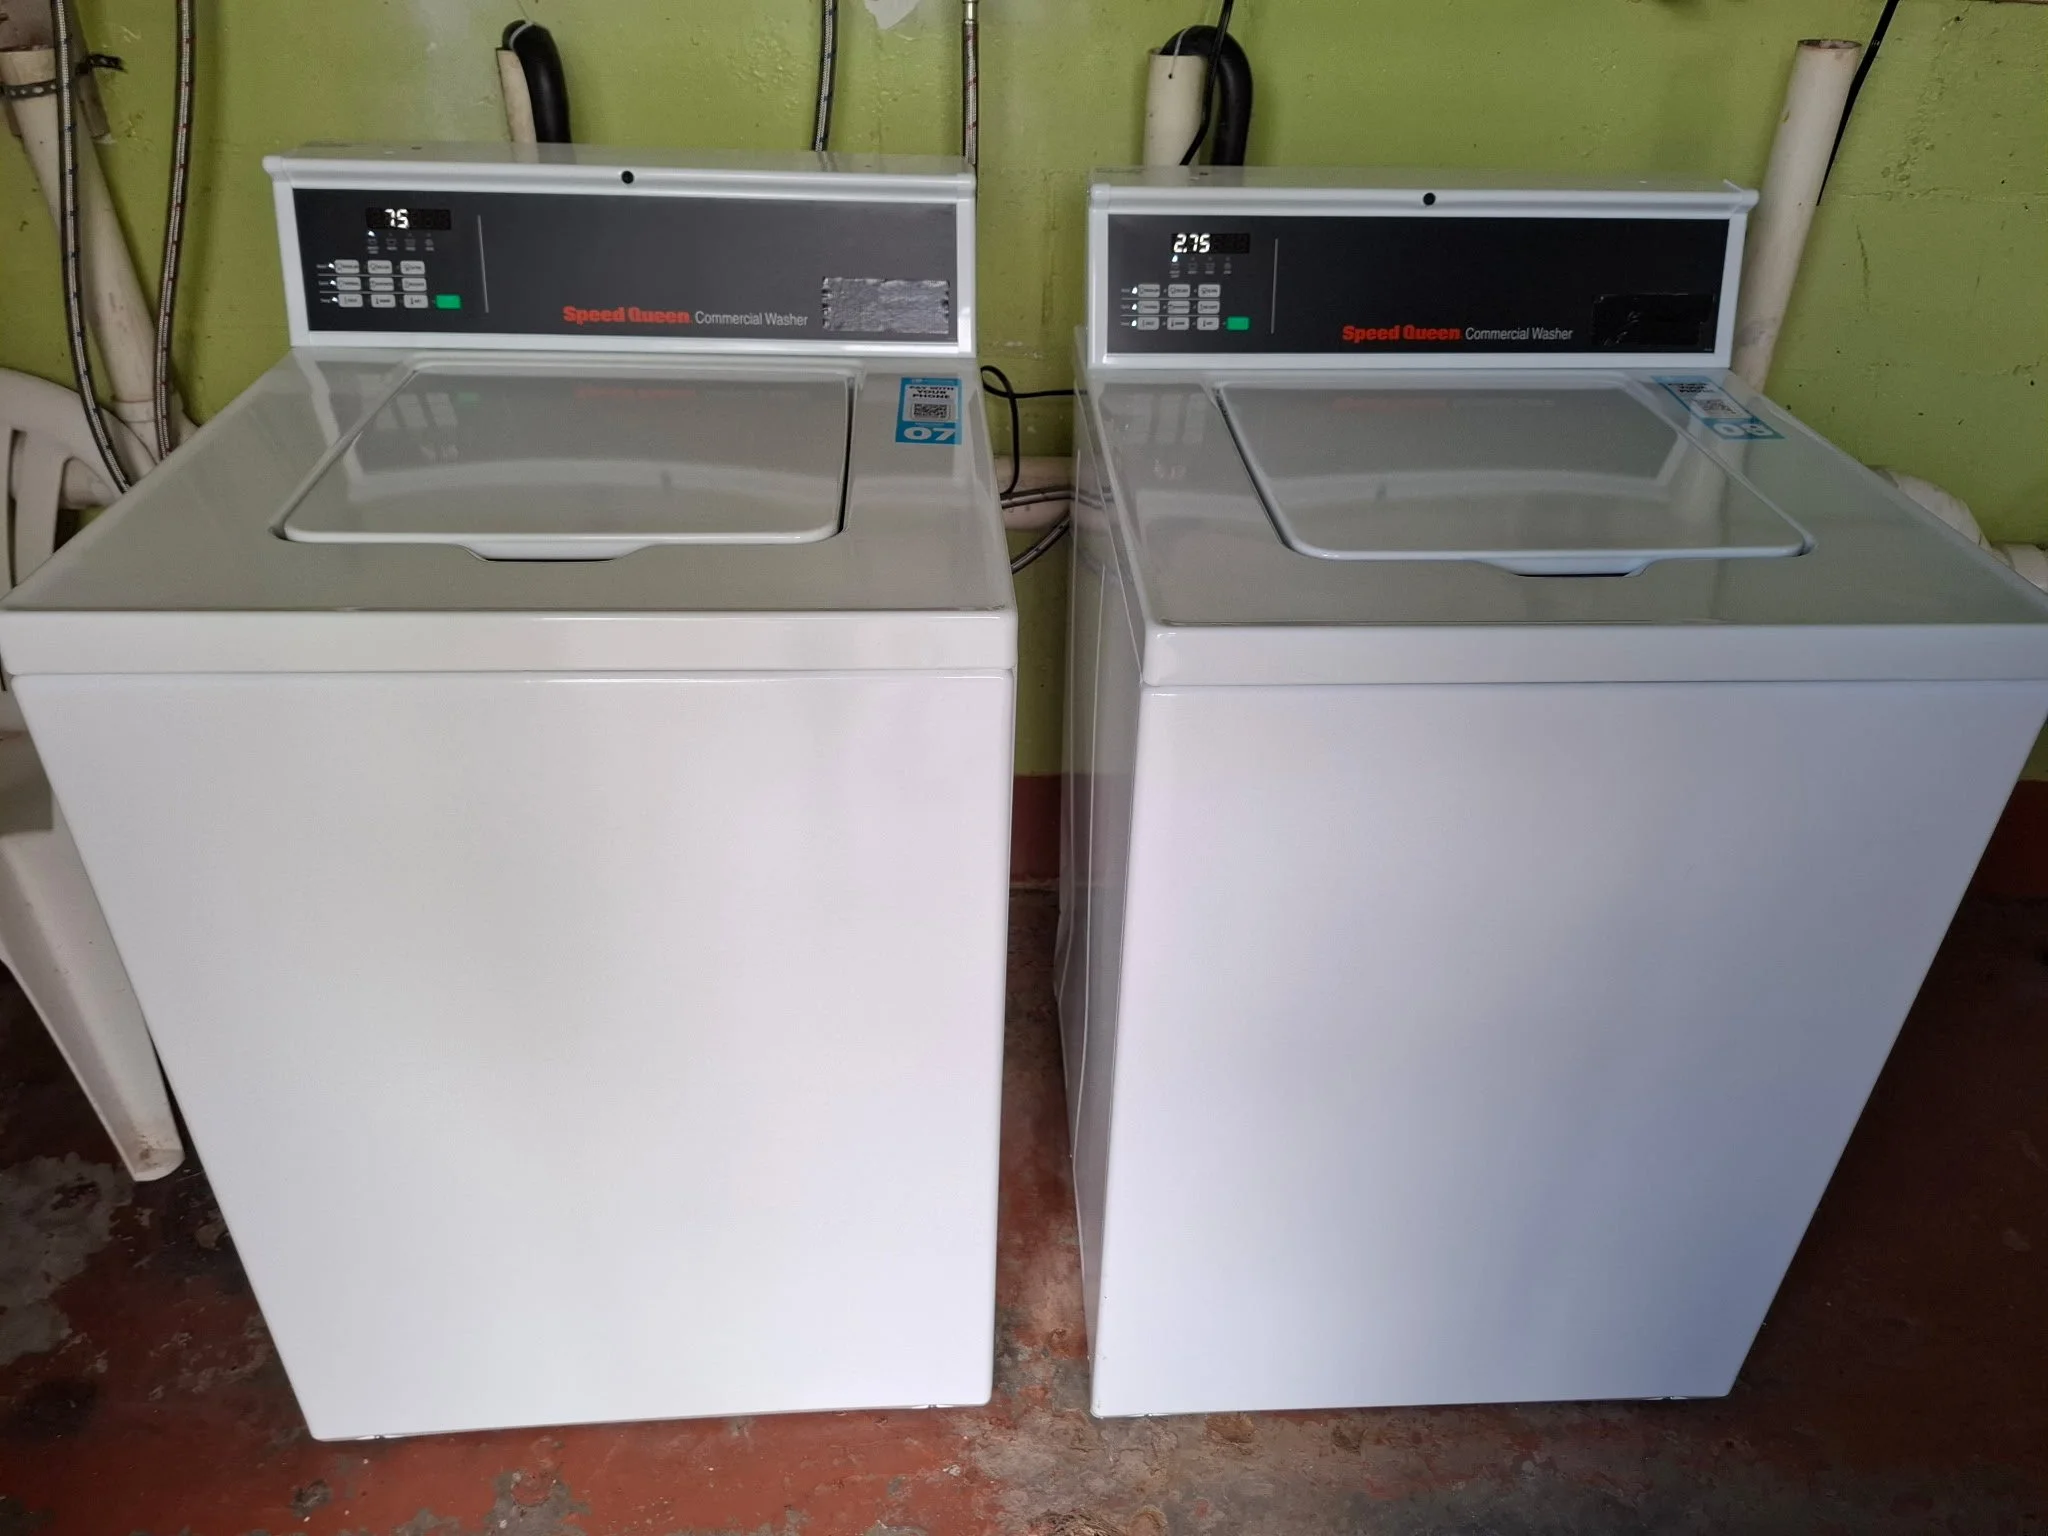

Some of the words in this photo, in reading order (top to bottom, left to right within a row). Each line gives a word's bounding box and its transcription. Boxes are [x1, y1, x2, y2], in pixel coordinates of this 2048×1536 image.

[384, 208, 410, 229] 75
[1173, 233, 1211, 253] 2.75
[562, 305, 625, 325] Speed
[628, 307, 691, 325] Queen
[695, 310, 763, 326] Commercial
[765, 311, 808, 327] Washer
[1342, 325, 1400, 343] Speed
[1402, 326, 1461, 341] Queen
[1465, 326, 1530, 341] Commercial
[1531, 327, 1574, 341] Washer
[903, 426, 956, 441] 07
